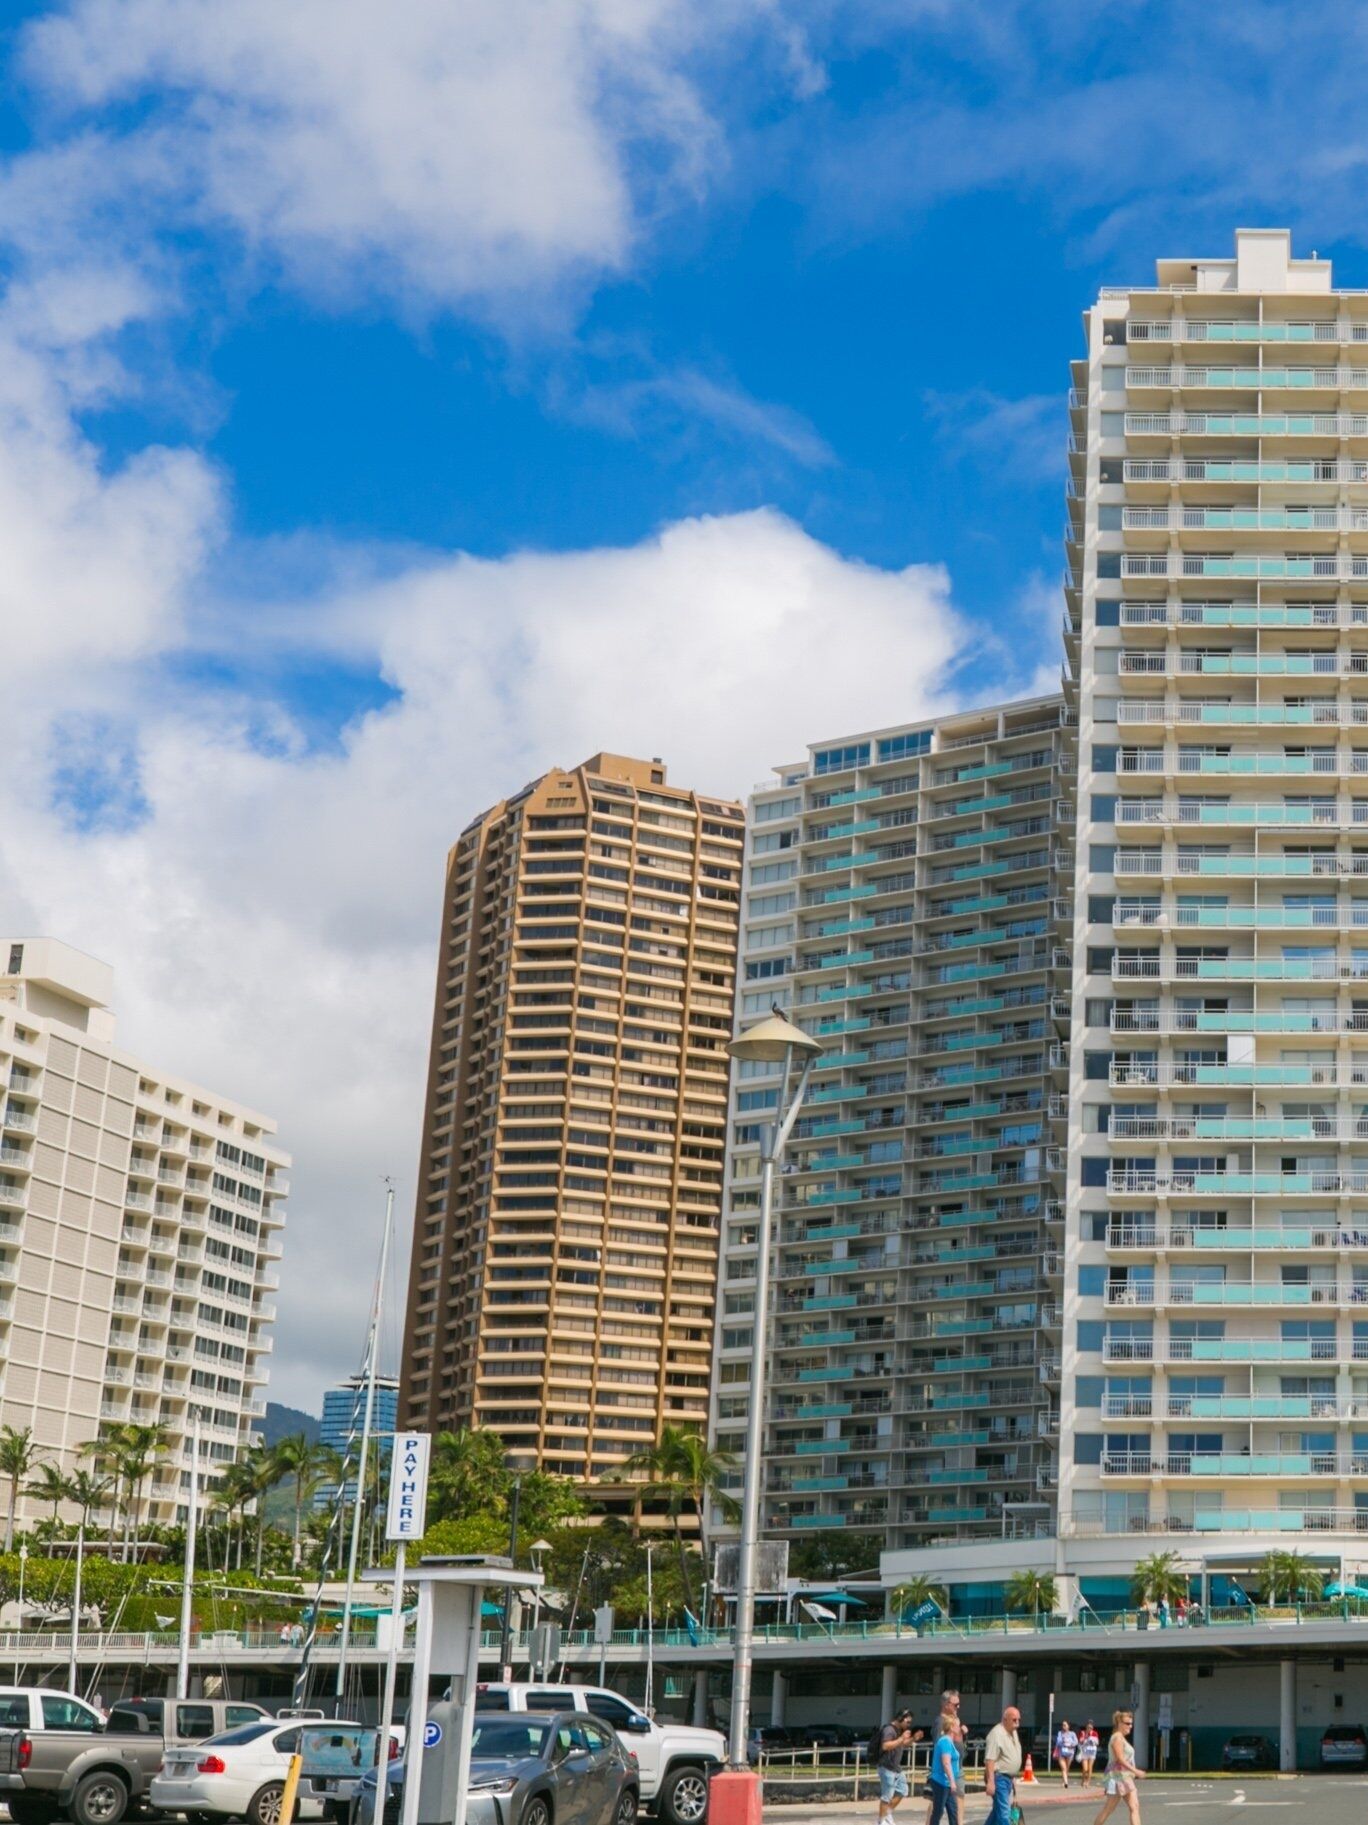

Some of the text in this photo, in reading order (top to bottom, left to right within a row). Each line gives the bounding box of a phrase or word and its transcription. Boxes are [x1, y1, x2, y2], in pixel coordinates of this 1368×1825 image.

[399, 1440, 418, 1532] PAY HERE
[425, 1726, 437, 1743] P
